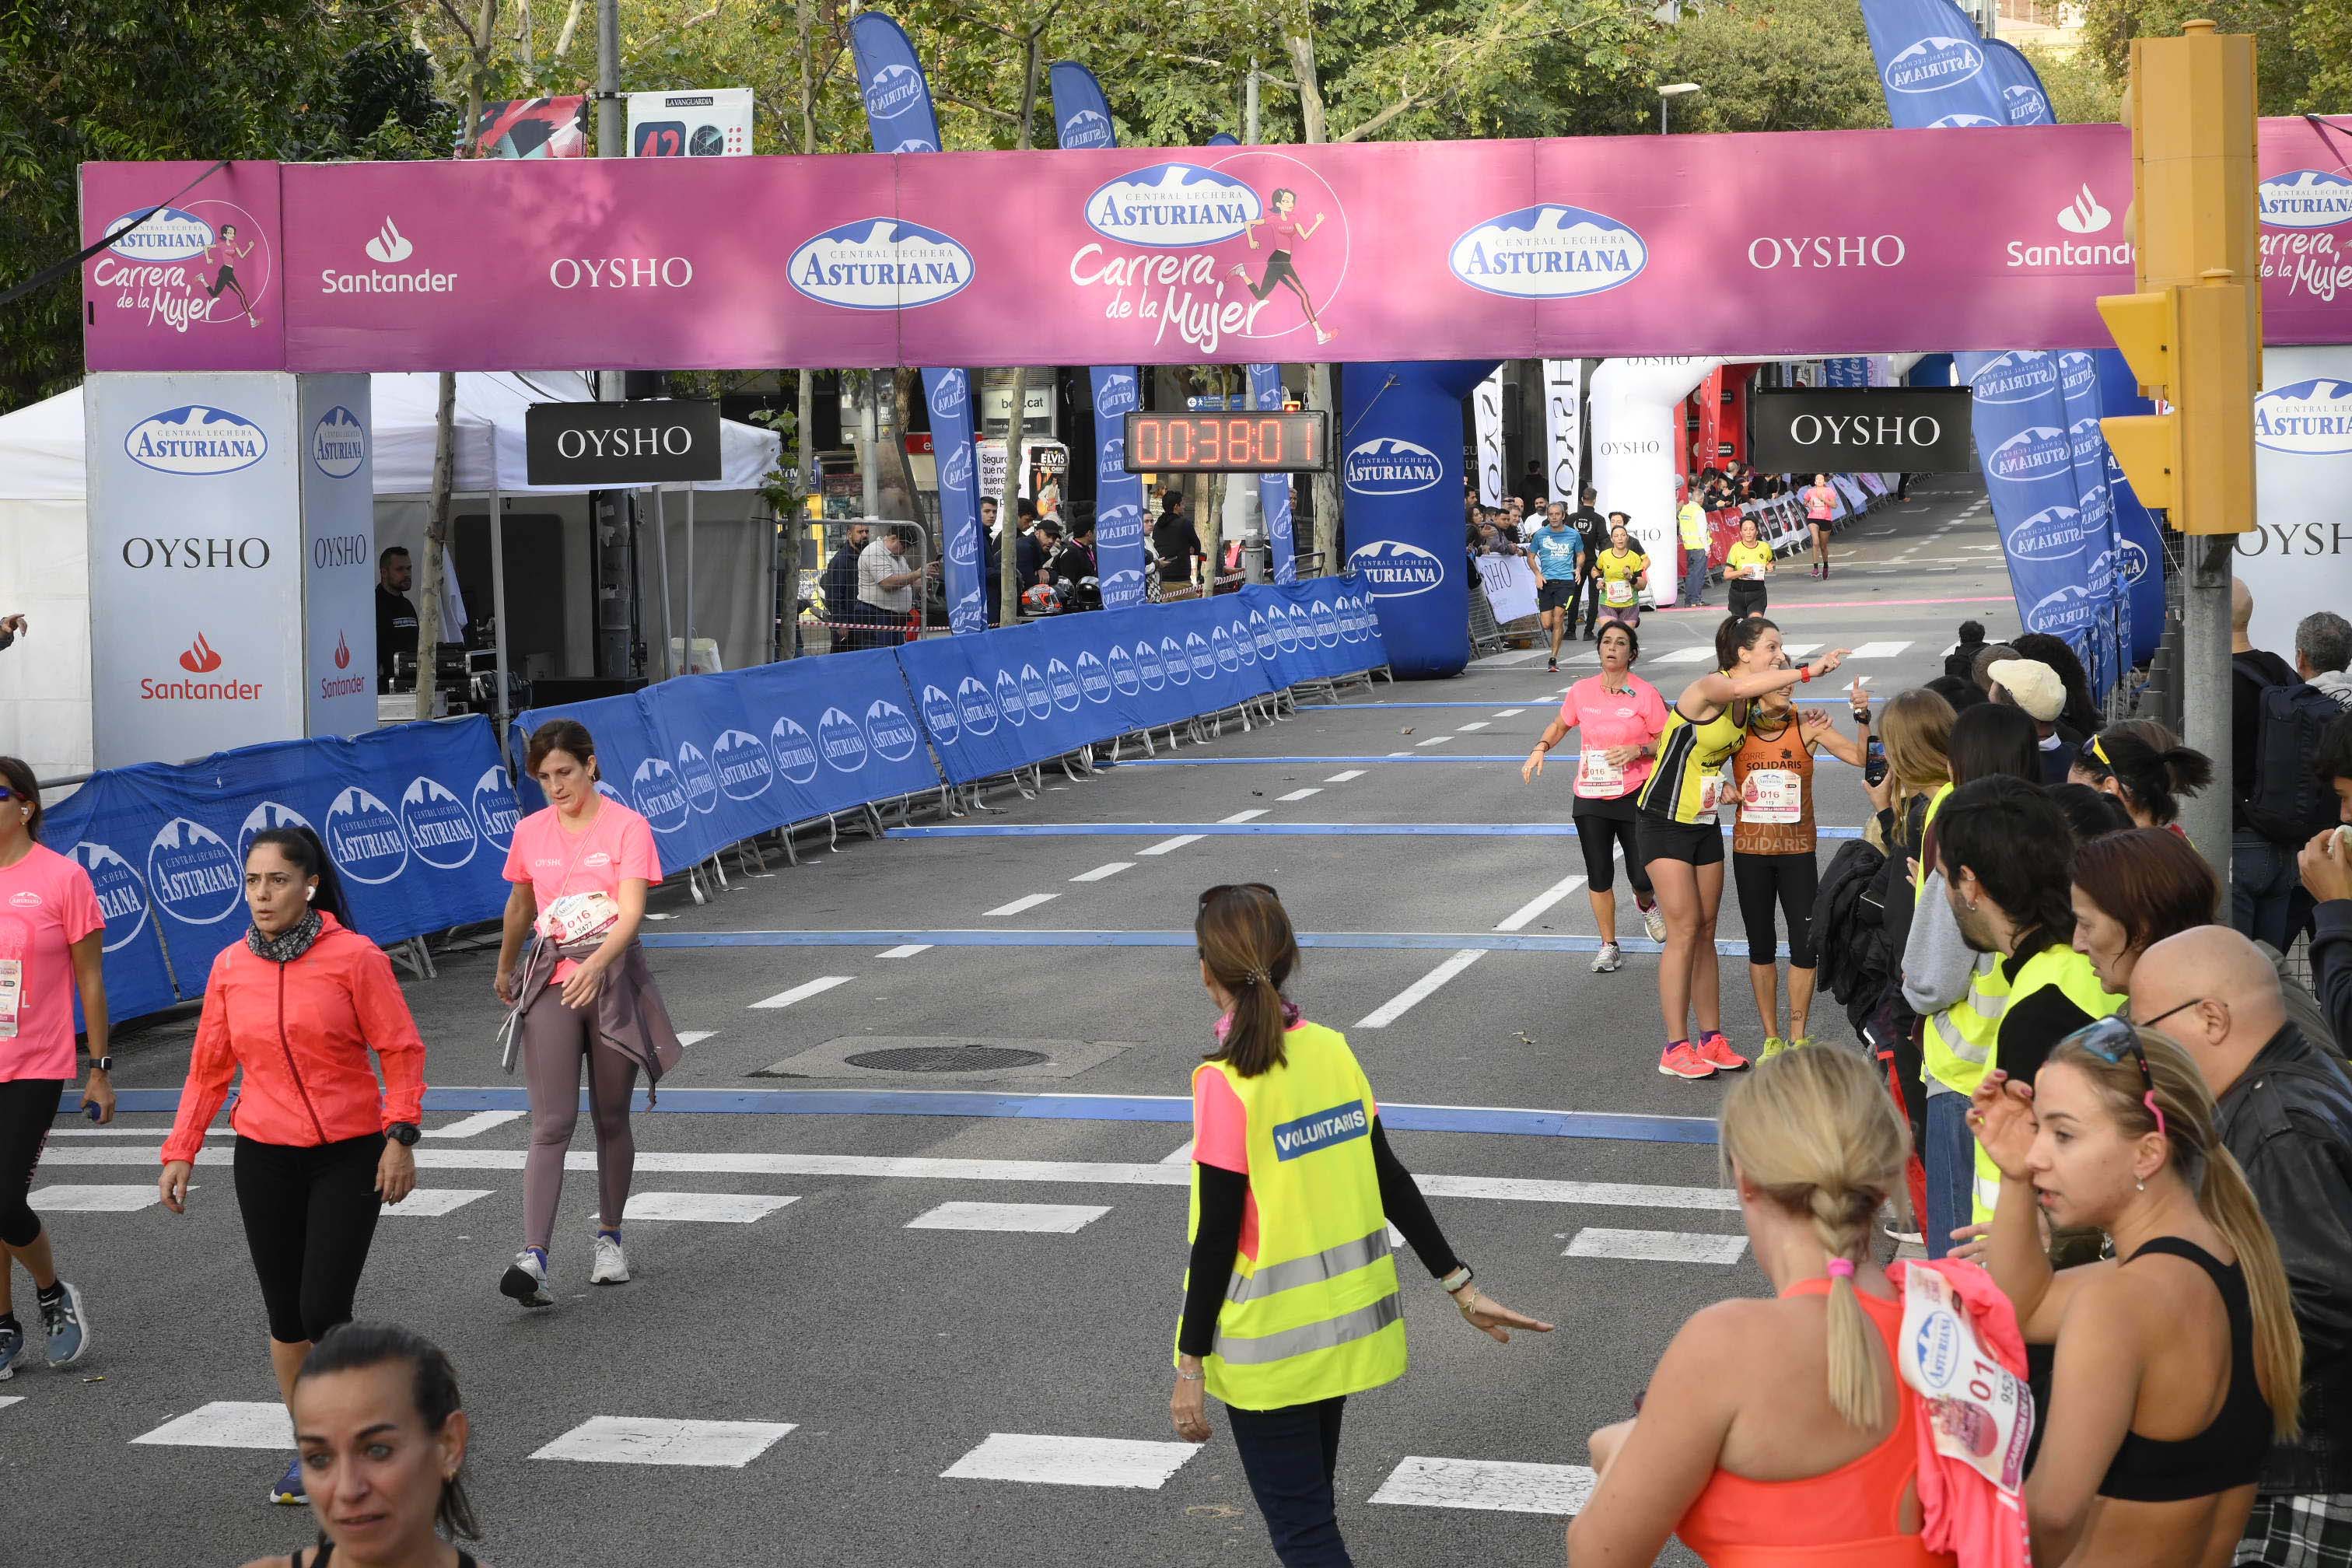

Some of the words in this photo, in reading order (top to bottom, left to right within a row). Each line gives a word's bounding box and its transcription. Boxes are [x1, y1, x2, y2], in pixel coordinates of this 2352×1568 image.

[1125, 193, 1181, 201] CENTRAL
[1185, 191, 1243, 200] LECHERA
[1099, 195, 1248, 226] ASTURIANA
[114, 226, 205, 247] ASTURIANA
[1495, 236, 1556, 247] CENTRAL
[1563, 235, 1626, 246] LECHERA
[2260, 233, 2333, 254] arrera
[831, 250, 887, 259] CENTRAL
[895, 249, 954, 258] LECHERA
[1069, 243, 1216, 286] Carrera
[1465, 240, 1633, 275] ASTURIANA
[1748, 234, 1905, 269] OYSHO
[2007, 240, 2135, 266] Santand
[94, 258, 186, 287] Carrera
[321, 268, 458, 293] Santander
[550, 257, 693, 289] OYSHO
[801, 253, 960, 285] ASTURIANA
[2278, 257, 2292, 278] la
[2289, 252, 2352, 302] Muje
[117, 289, 134, 309] de
[138, 289, 150, 309] la
[148, 285, 221, 333] Mujer
[1105, 289, 1132, 318] de
[1139, 287, 1158, 318] la
[1154, 280, 1269, 354] Mujer
[557, 425, 692, 458] OYSHO
[1790, 415, 1941, 446] OYSHO
[136, 432, 257, 458] ASTURIANA
[317, 432, 362, 460] ASTURIANA
[1601, 440, 1660, 456] OYSHO
[982, 467, 996, 476] que
[1041, 453, 1065, 464] ELVIS
[1348, 461, 1436, 482] ASTURIANA
[315, 534, 366, 569] OYSHO
[2235, 522, 2352, 556] OYSH
[122, 537, 270, 569] OYSHO
[1364, 569, 1437, 583] TURIANA
[141, 678, 263, 700] Santander
[321, 674, 365, 699] Santander
[1739, 752, 1765, 761] CORRE
[1746, 761, 1802, 771] SOLIDARIS
[716, 757, 771, 786] ASTURIANA
[415, 809, 436, 820] CENTRAL
[437, 804, 460, 816] LECHERA
[487, 796, 513, 808] CENTRAL
[341, 819, 367, 831] CENTRAL
[369, 817, 392, 828] LECHERA
[408, 814, 474, 850] ASTURIANA
[333, 826, 404, 864] ASTURIANA
[1734, 837, 1809, 851] OLIDARIS
[166, 856, 197, 869] CENTRAL
[198, 849, 226, 863] LECHERA
[157, 862, 238, 903] ASTURIANA
[99, 885, 142, 920] RIANA
[567, 910, 591, 929] 016
[574, 921, 593, 936] 13477
[1276, 1109, 1367, 1152] VOLUNTARIS
[1929, 1319, 1951, 1381] ASTURIANA
